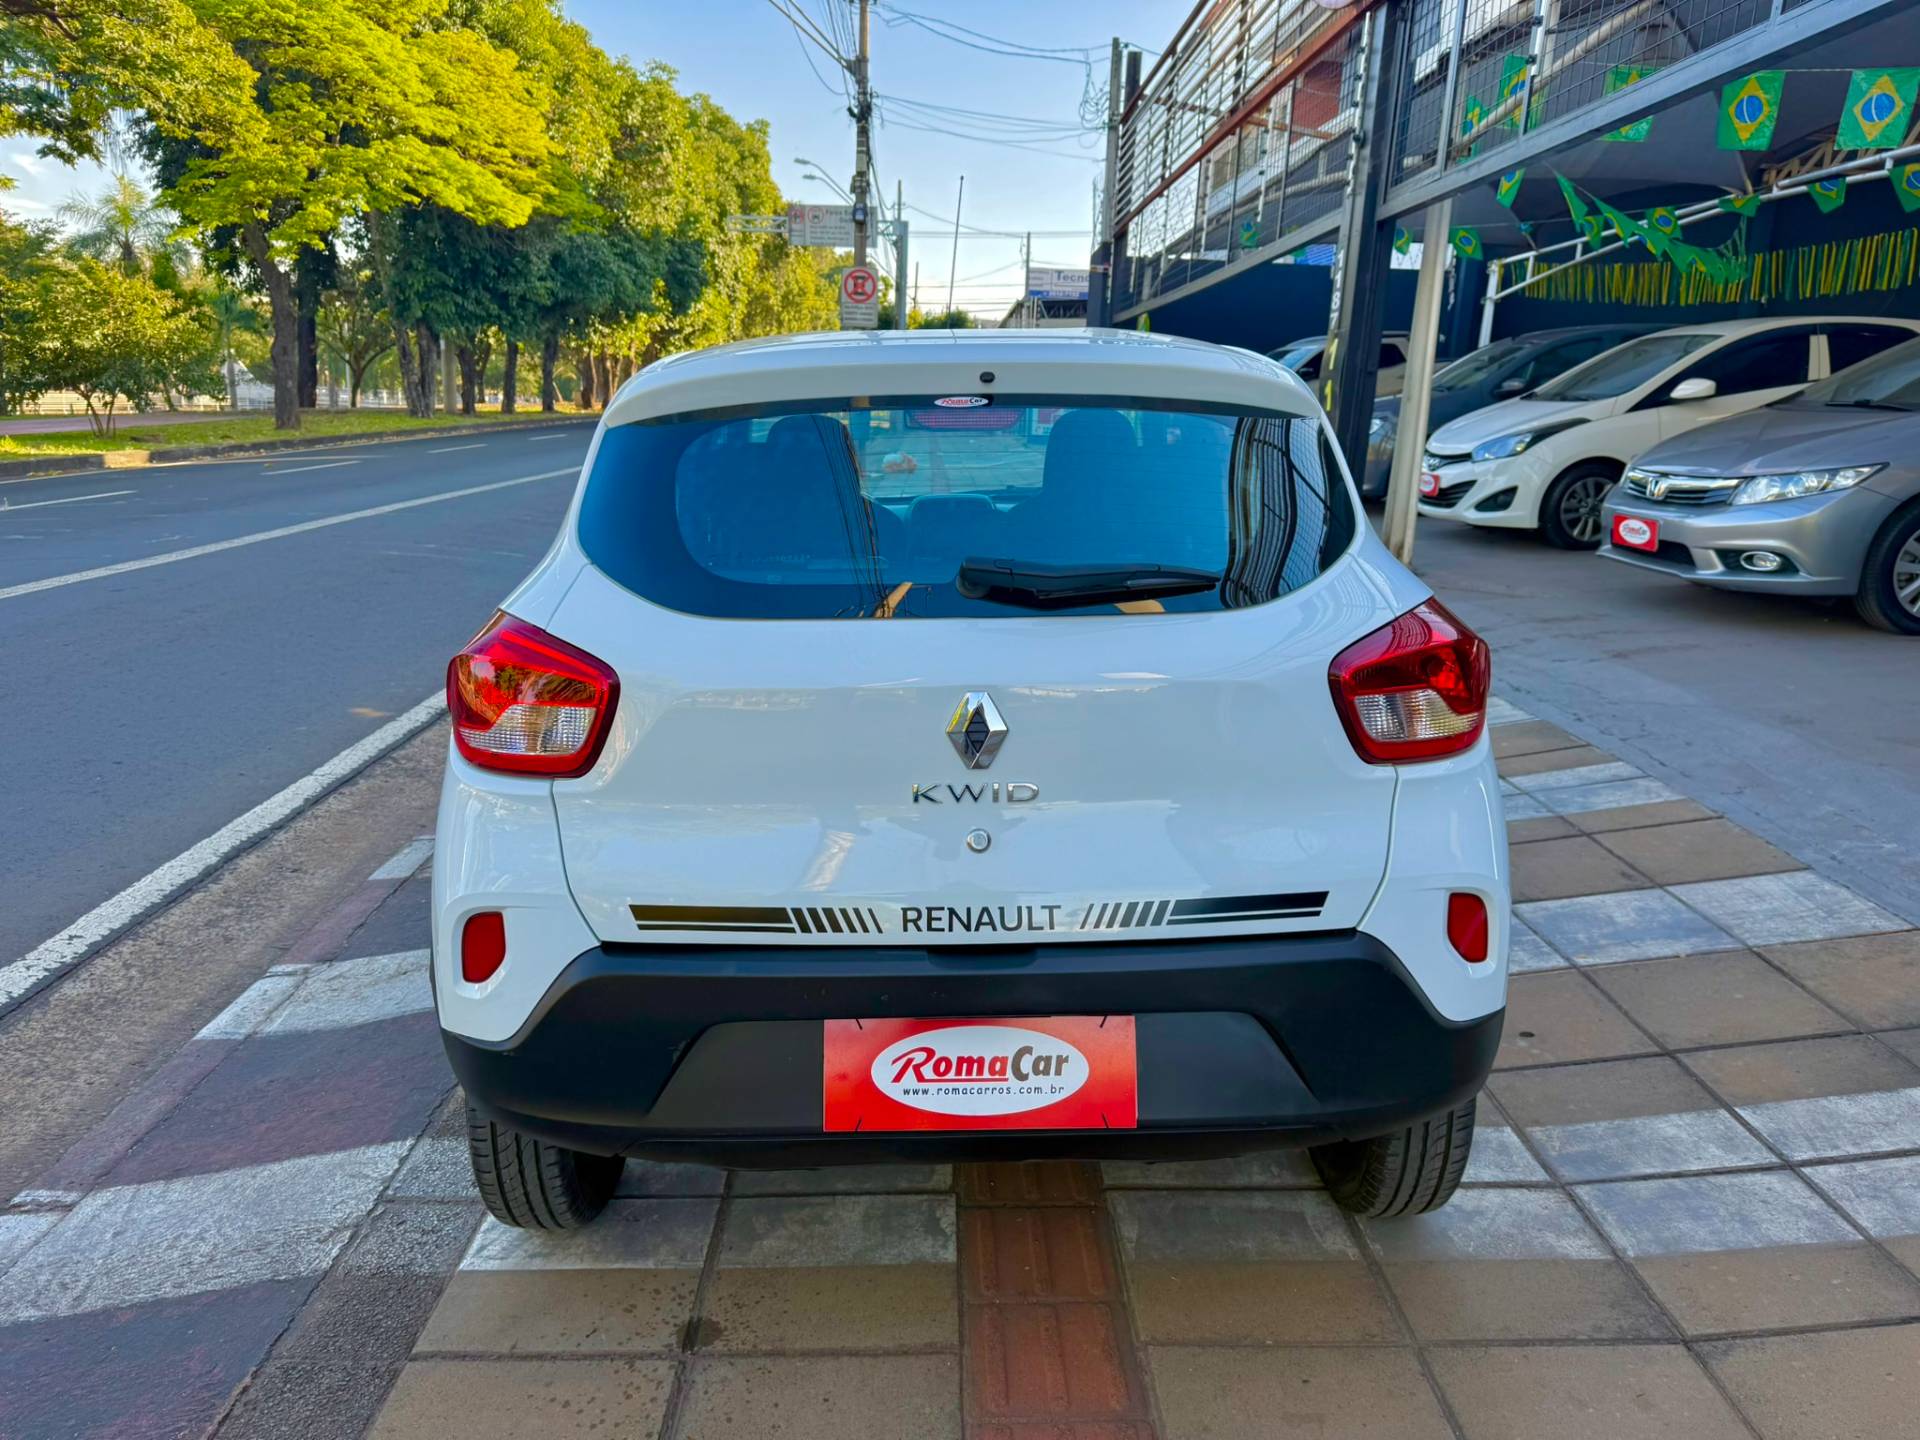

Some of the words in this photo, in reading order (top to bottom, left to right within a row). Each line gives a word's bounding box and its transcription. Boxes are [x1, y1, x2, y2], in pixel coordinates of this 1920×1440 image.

[911, 783, 1040, 804] KWID
[901, 905, 1062, 933] RENAULT
[890, 1045, 1070, 1083] RomaCar
[902, 1084, 1065, 1096] www.romacarros.com.br
